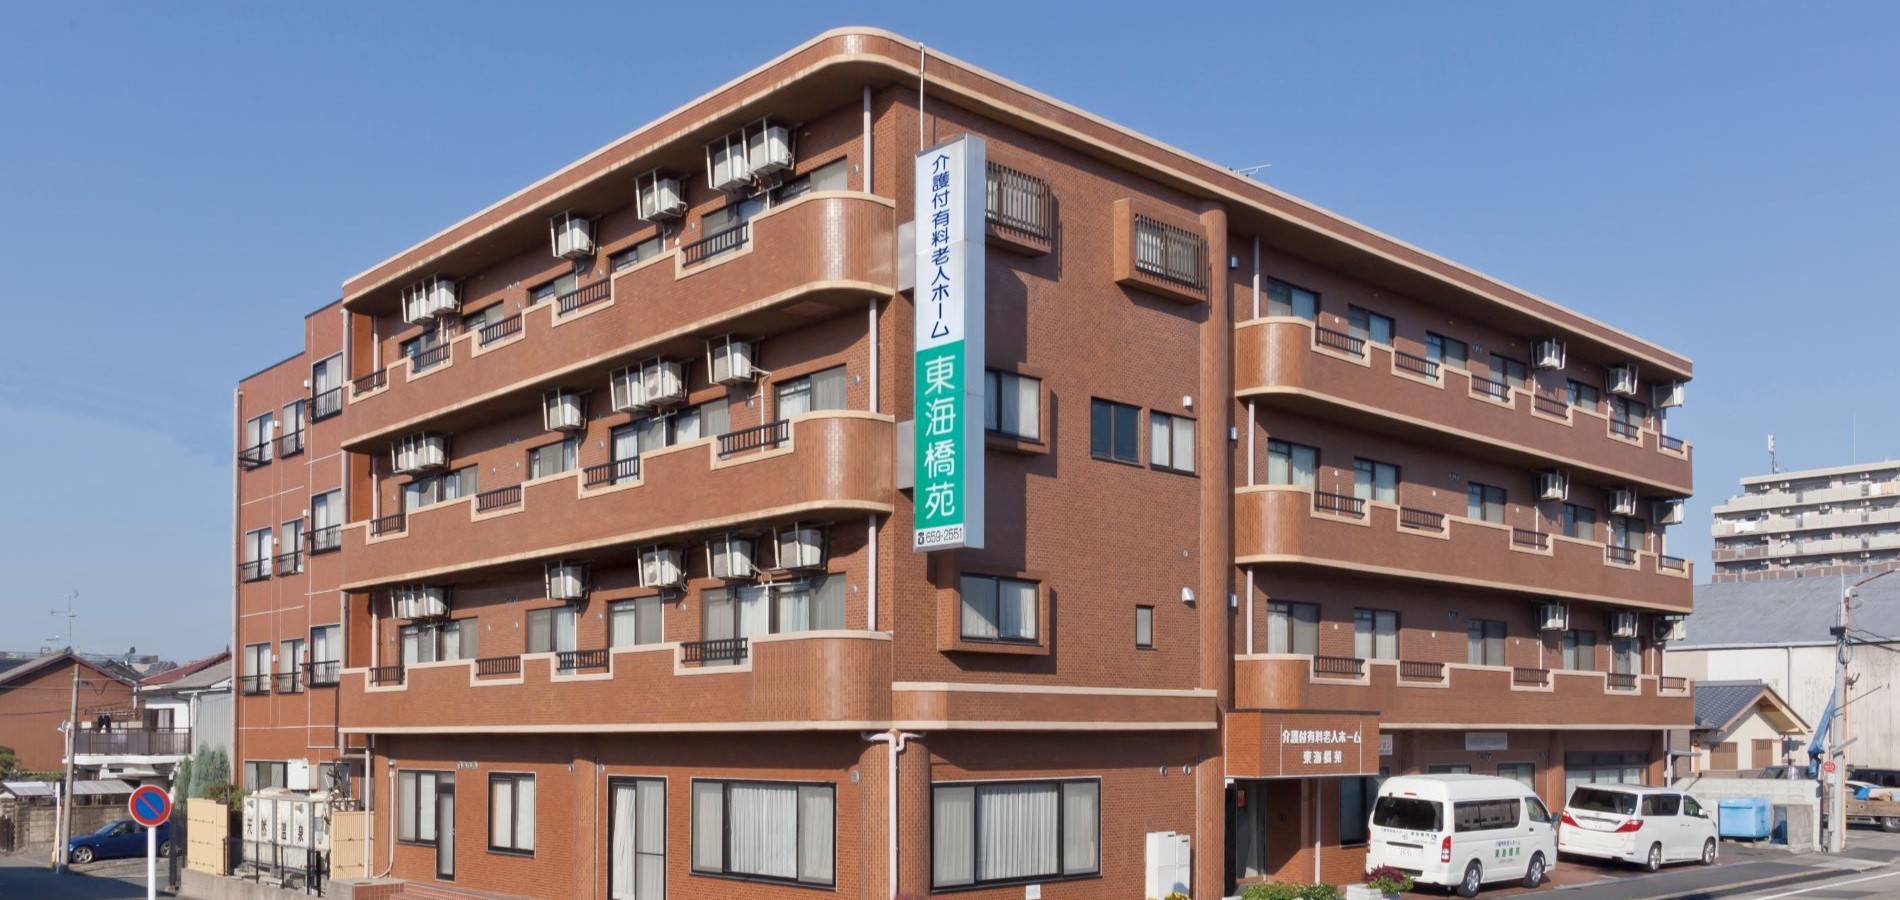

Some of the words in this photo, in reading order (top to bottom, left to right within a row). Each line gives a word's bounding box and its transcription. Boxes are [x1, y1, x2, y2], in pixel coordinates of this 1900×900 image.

[931, 154, 950, 339] 介護付有料老人ホーム
[924, 355, 956, 520] 東海橋苑
[926, 527, 963, 543] 659-2551
[1282, 729, 1361, 744] 介護付有料老人ホーム
